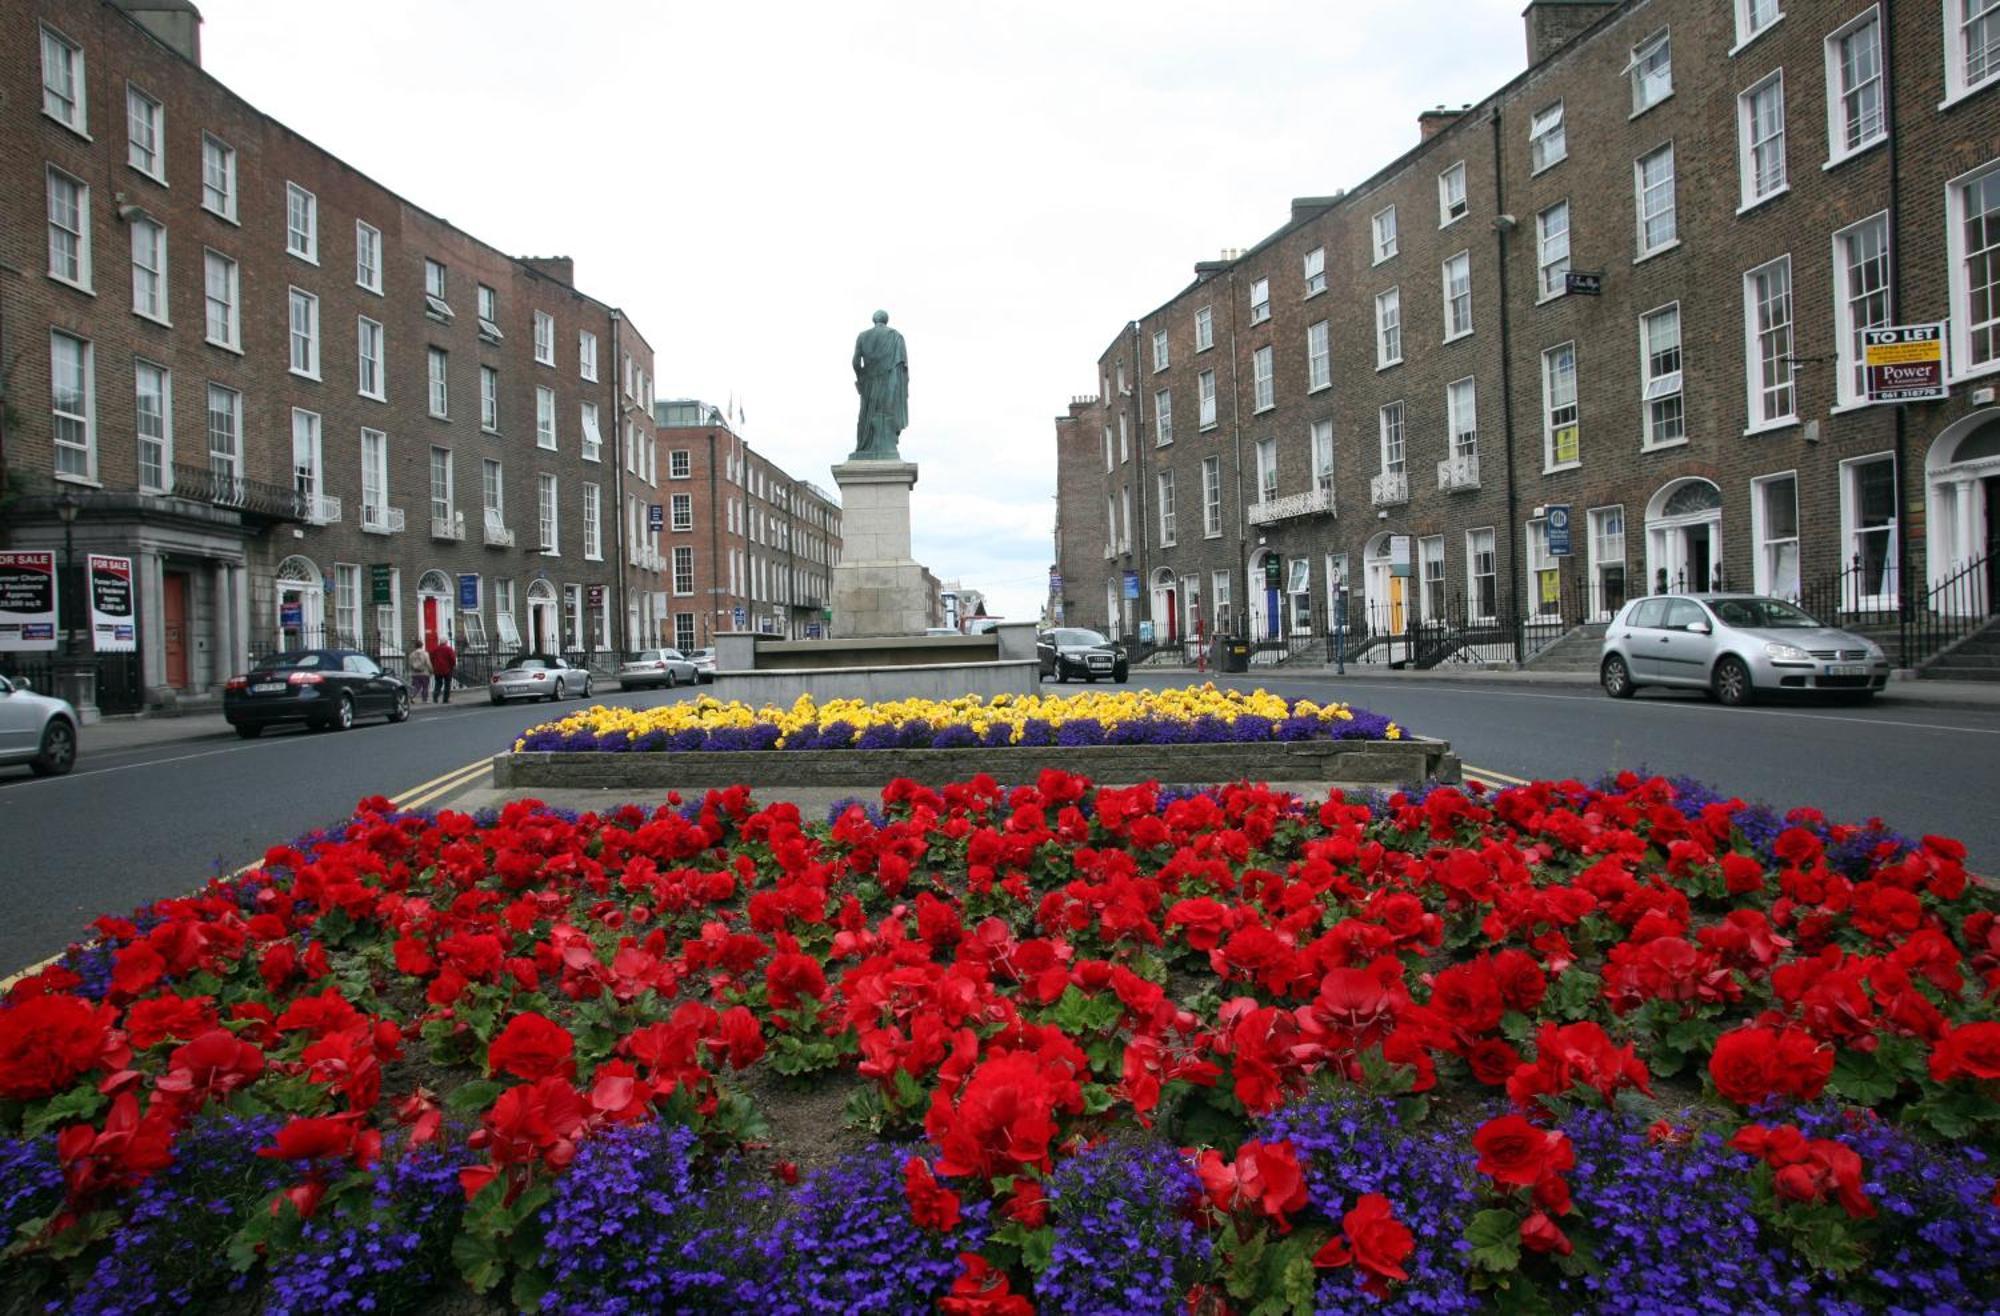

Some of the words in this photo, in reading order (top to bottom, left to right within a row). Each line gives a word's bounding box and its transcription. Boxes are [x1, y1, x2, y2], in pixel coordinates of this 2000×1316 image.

[1870, 331, 1897, 344] TO
[1903, 328, 1935, 341] LET
[1884, 366, 1933, 380] Power
[1881, 390, 1898, 400] 061
[0, 555, 15, 565] OR
[17, 555, 49, 565] SALE
[92, 559, 108, 569] FOR
[109, 561, 129, 570] SALE
